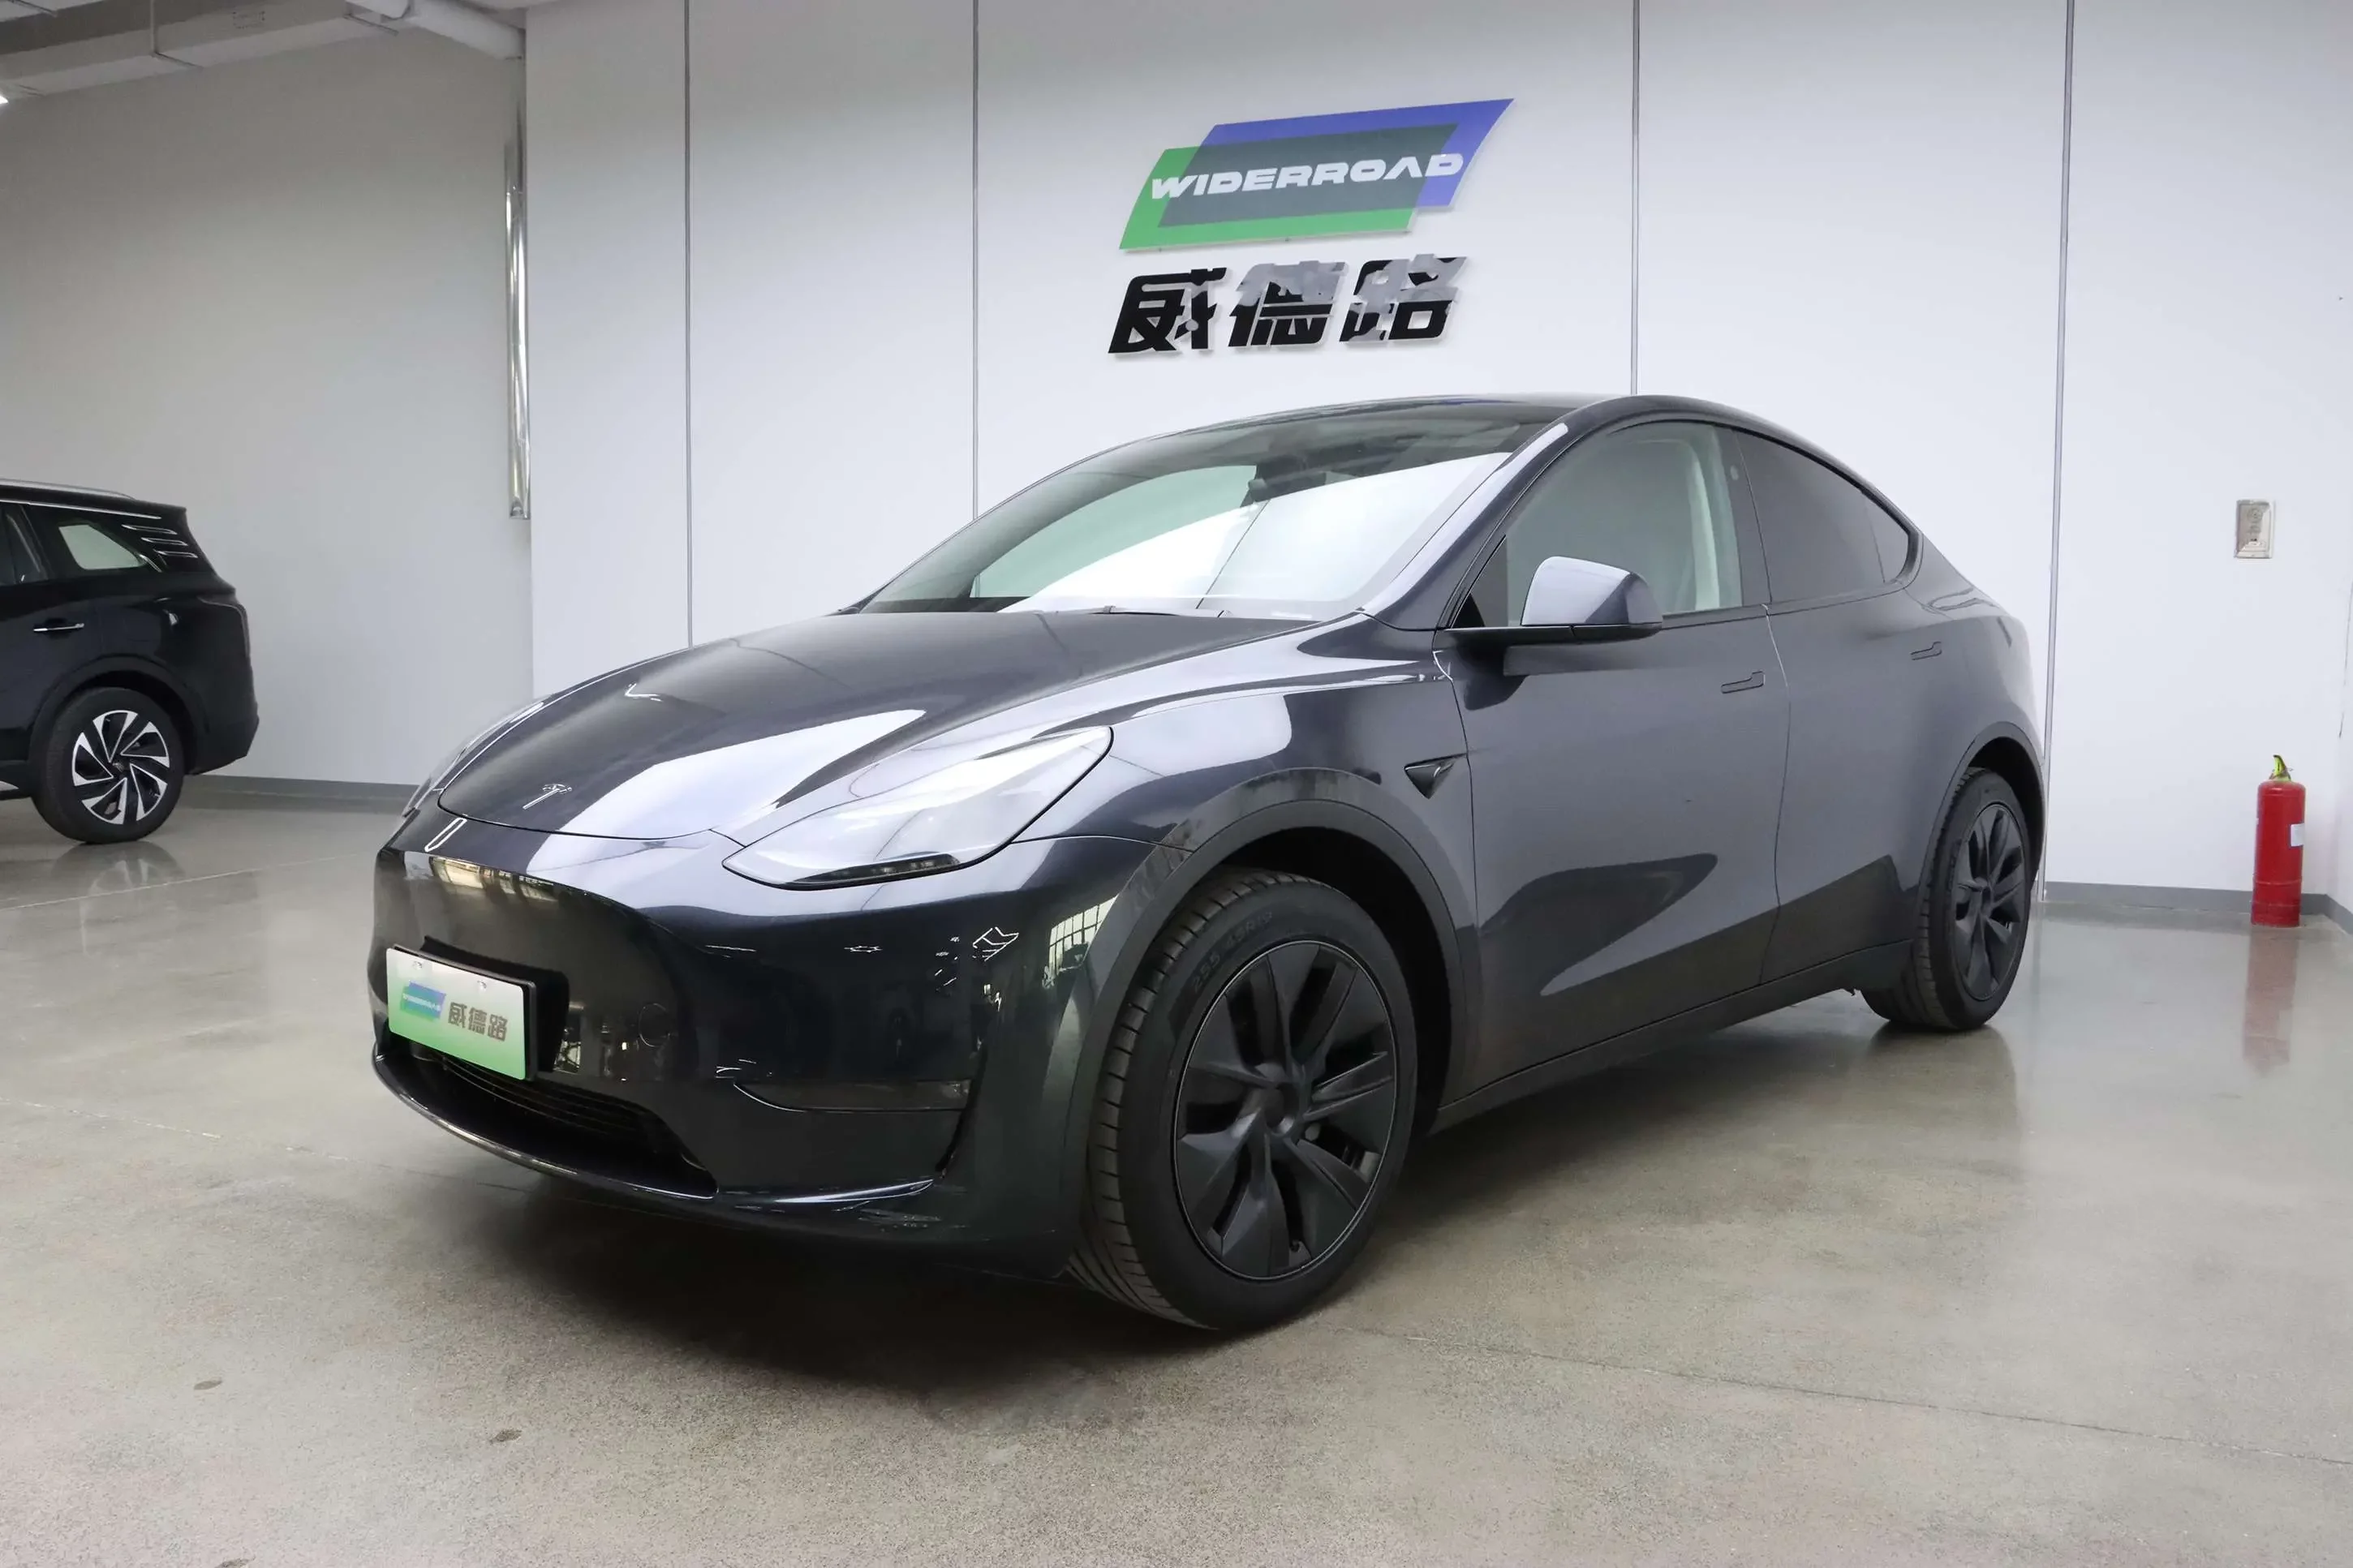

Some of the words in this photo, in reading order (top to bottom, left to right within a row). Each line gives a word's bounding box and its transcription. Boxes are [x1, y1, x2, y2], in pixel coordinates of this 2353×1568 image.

[1151, 153, 1464, 200] WIDERROAD
[1108, 254, 1468, 354] 威德路
[449, 1003, 508, 1042] 威德路
